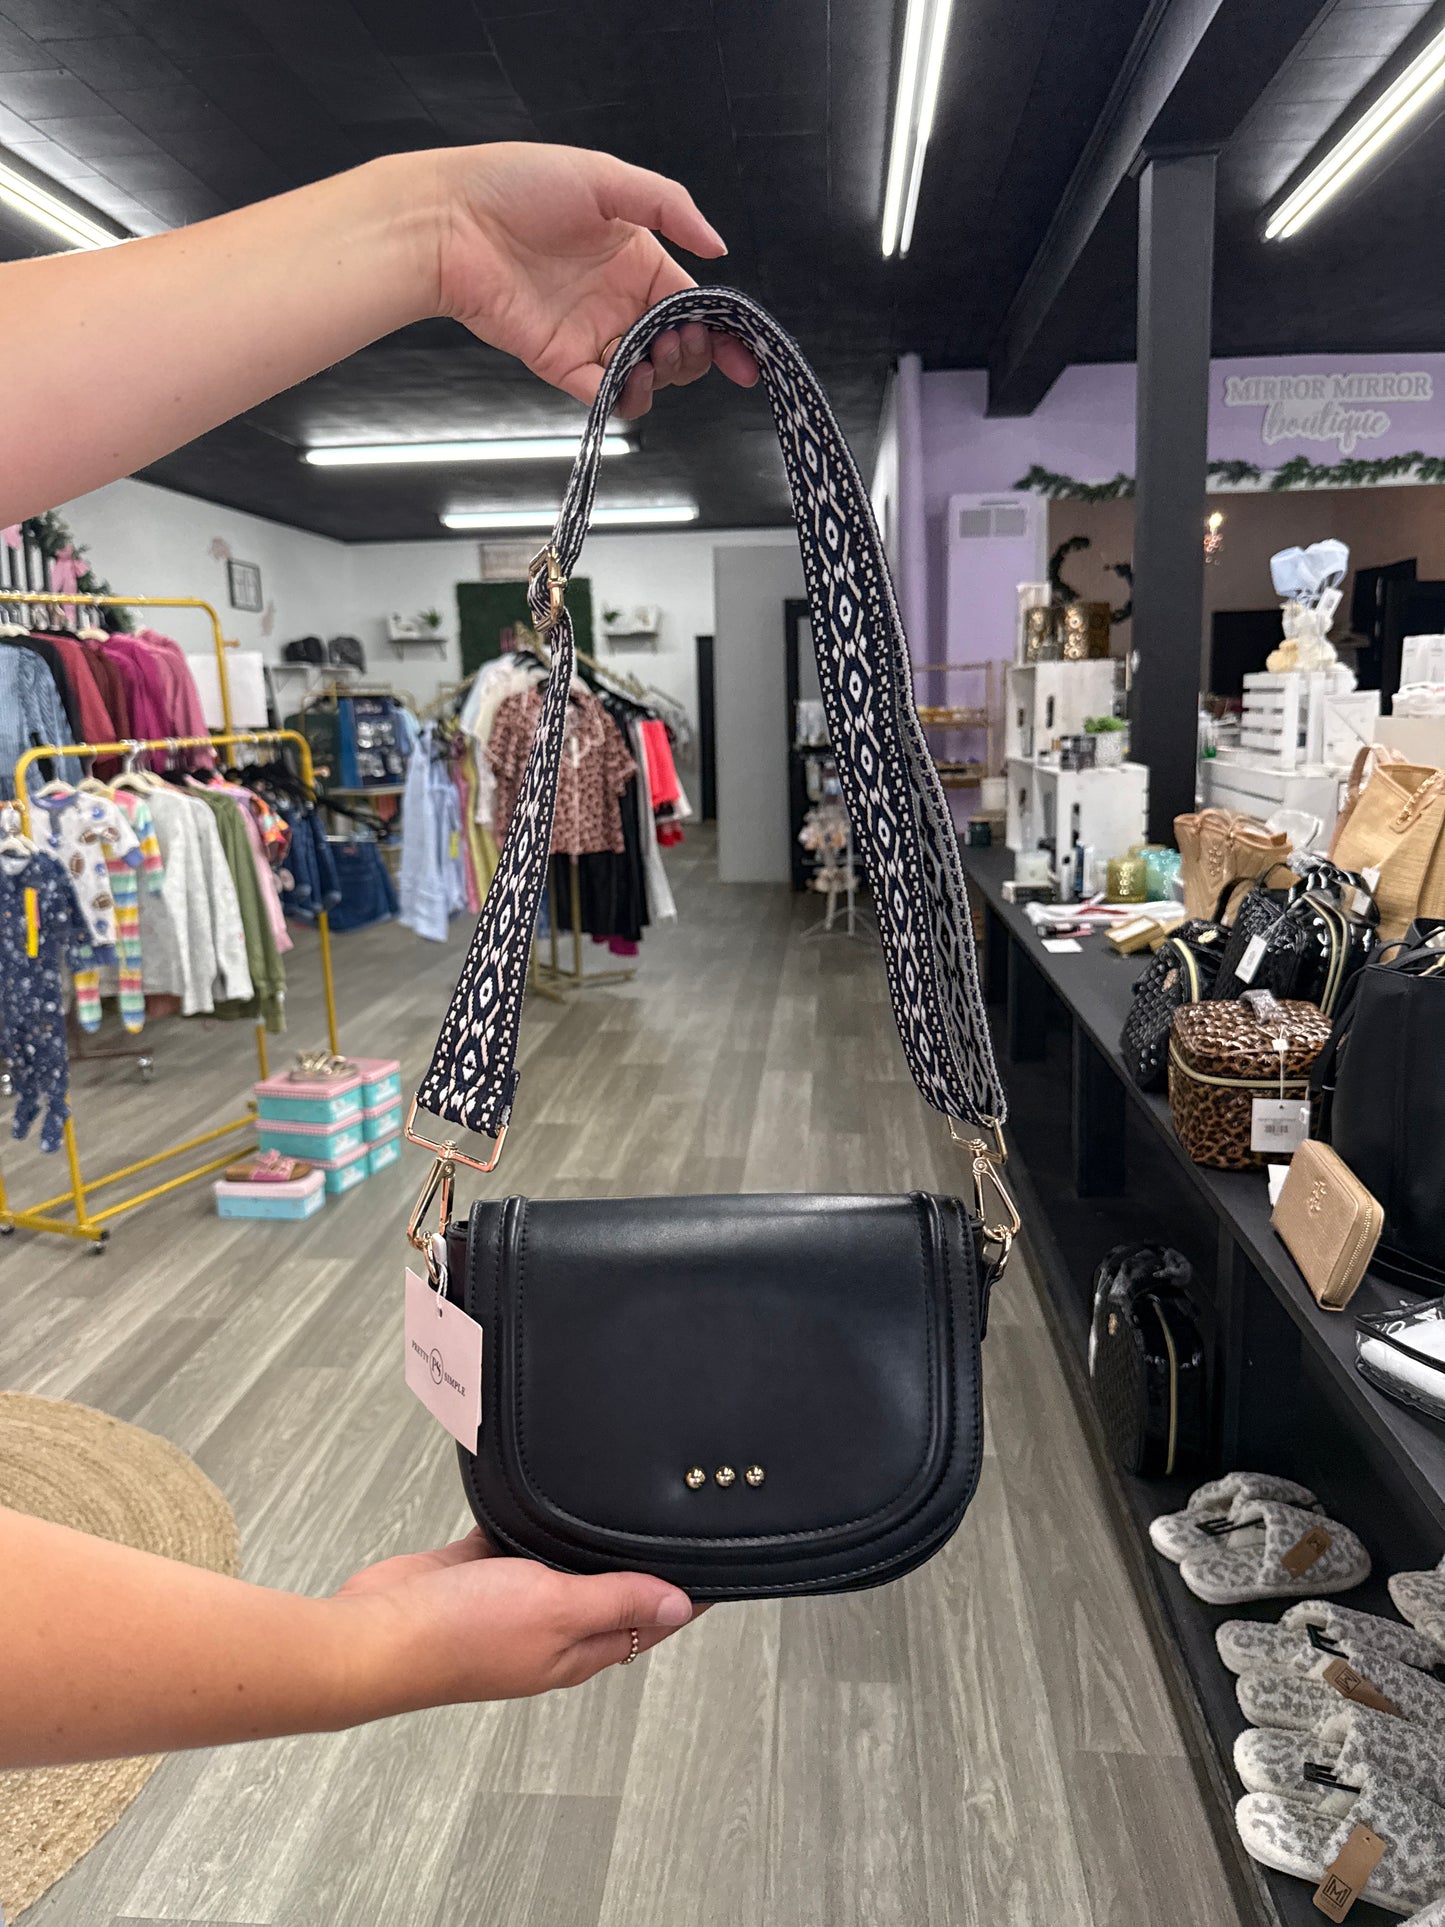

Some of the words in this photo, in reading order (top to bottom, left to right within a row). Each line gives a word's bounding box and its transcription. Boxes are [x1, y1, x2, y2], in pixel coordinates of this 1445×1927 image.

[1229, 378, 1326, 401] MIRROR
[1332, 375, 1430, 398] MIRROR
[1266, 401, 1385, 450] boutique
[411, 1339, 429, 1363] PRETTY
[444, 1372, 466, 1397] SIMPLE
[1326, 1878, 1349, 1904] M
